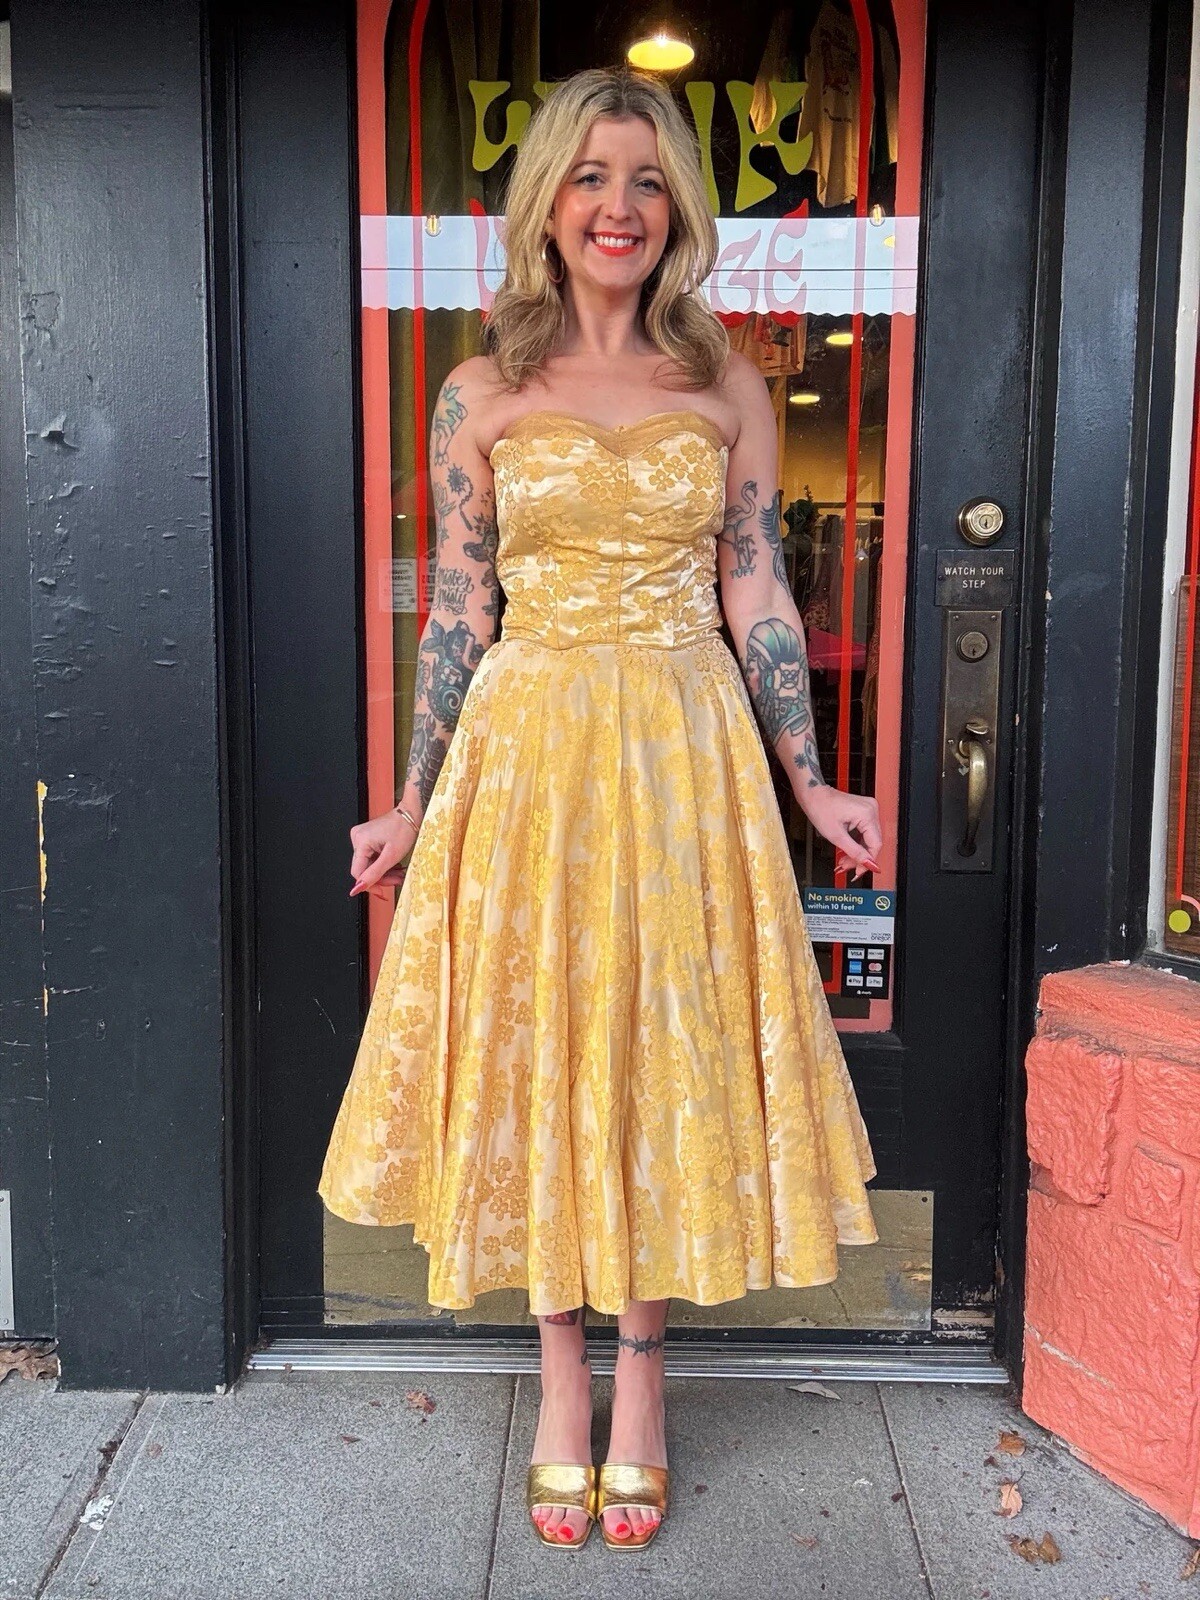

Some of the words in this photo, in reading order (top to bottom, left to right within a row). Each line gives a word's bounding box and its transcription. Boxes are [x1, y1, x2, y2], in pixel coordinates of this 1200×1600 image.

[944, 567, 976, 576] WATCH
[980, 567, 1004, 576] YOUR
[962, 580, 986, 588] STEP
[808, 892, 822, 901] No
[824, 893, 864, 905] smoking
[807, 902, 830, 910] within
[841, 903, 855, 911] feet
